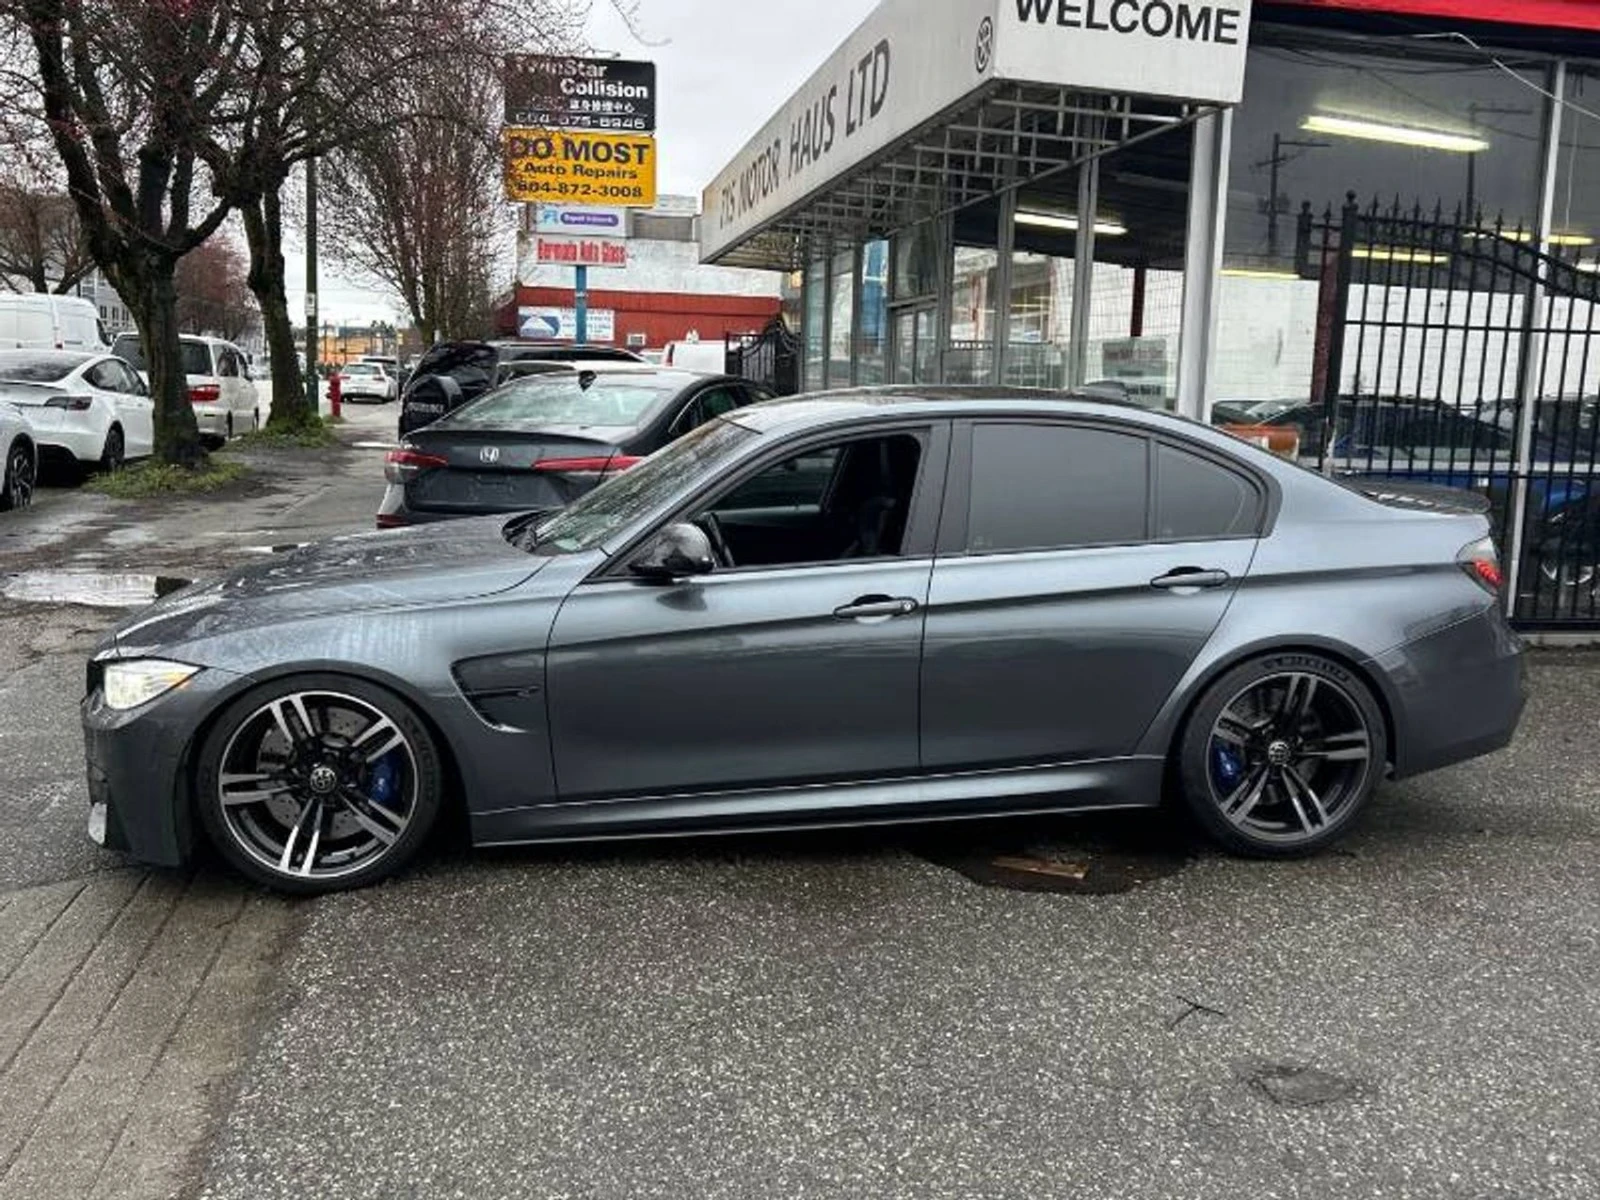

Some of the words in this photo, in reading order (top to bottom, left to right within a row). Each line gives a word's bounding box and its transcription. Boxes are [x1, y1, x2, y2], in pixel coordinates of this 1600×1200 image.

[1015, 0, 1241, 44] WELCOME
[560, 78, 649, 98] Collision
[788, 84, 837, 179] HAUS
[846, 38, 890, 138] LTD
[510, 136, 554, 159] DO
[562, 139, 650, 164] MOST
[523, 162, 567, 175] Auto
[572, 164, 638, 179] Repairs
[516, 181, 643, 197] 604-872-3008
